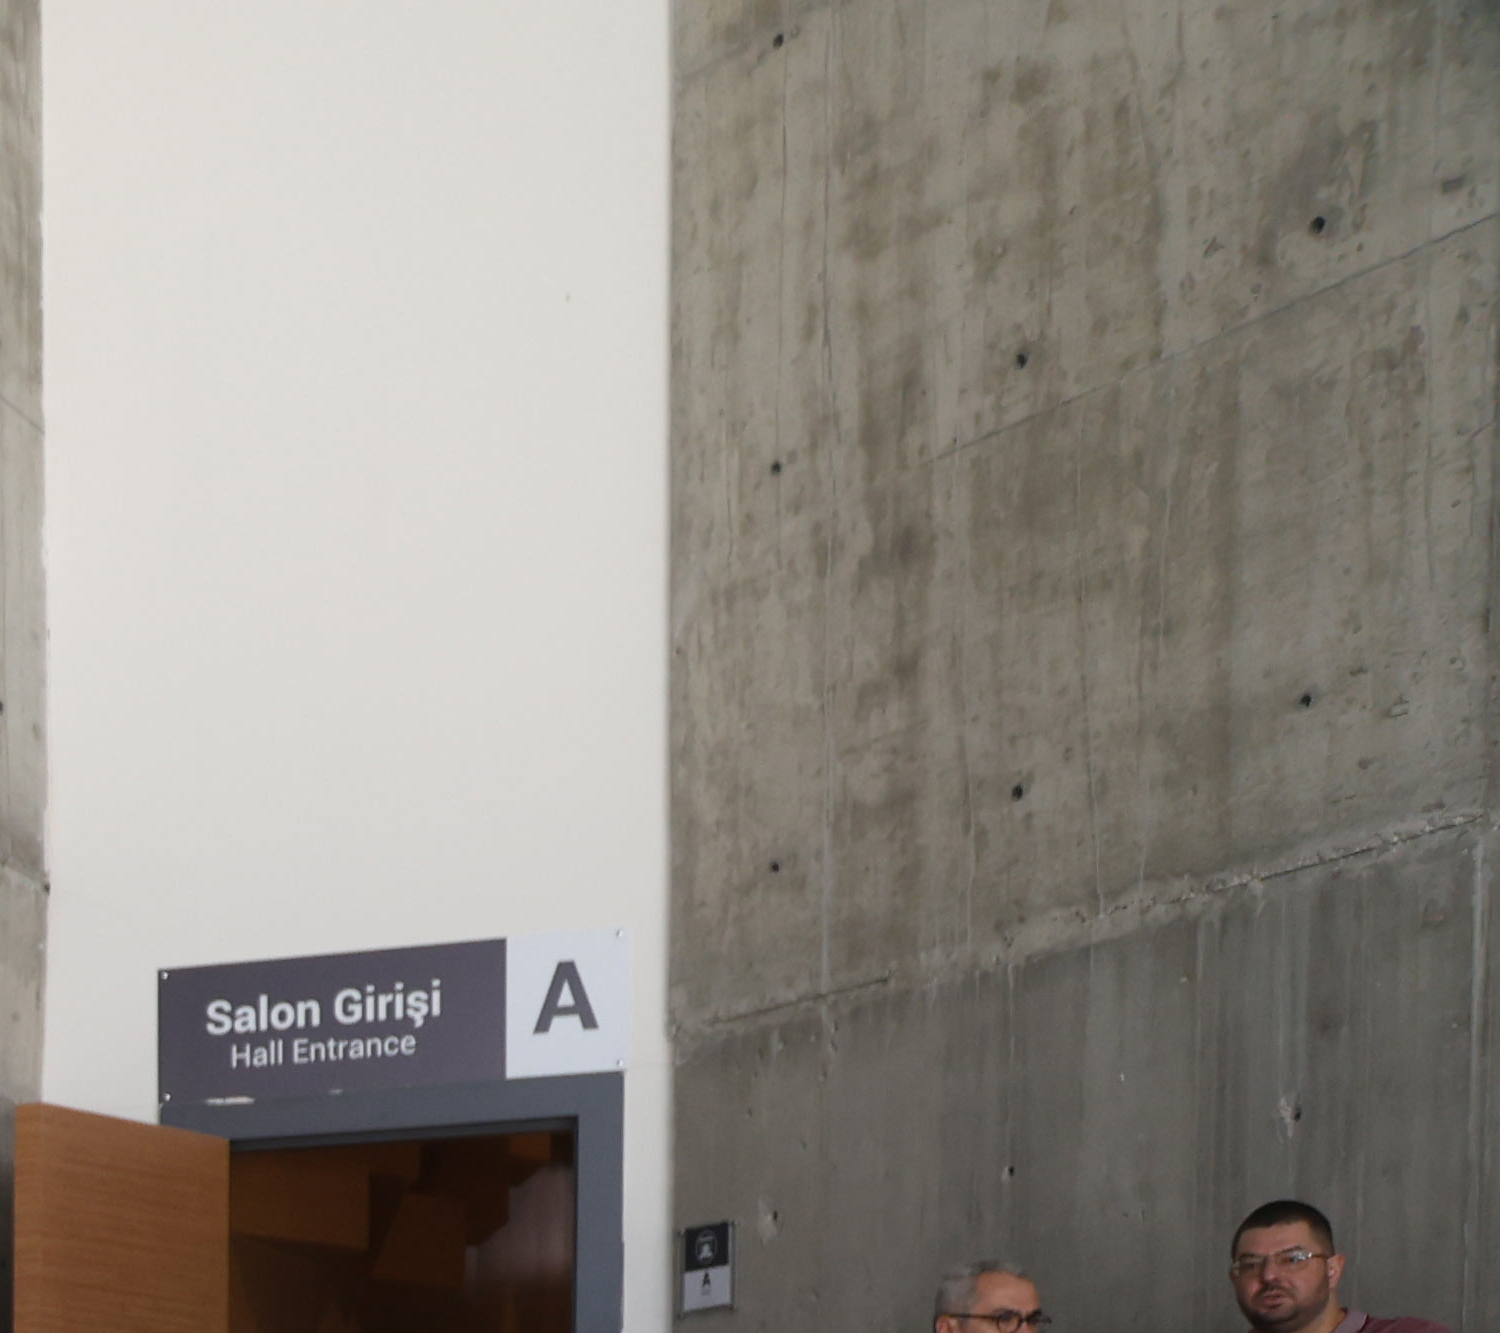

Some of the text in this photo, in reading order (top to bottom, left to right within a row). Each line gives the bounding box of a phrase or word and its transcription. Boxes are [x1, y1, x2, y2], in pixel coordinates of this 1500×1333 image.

[205, 978, 442, 1036] Salon Girişi
[532, 960, 600, 1035] A
[230, 1033, 417, 1069] Hall Entrance
